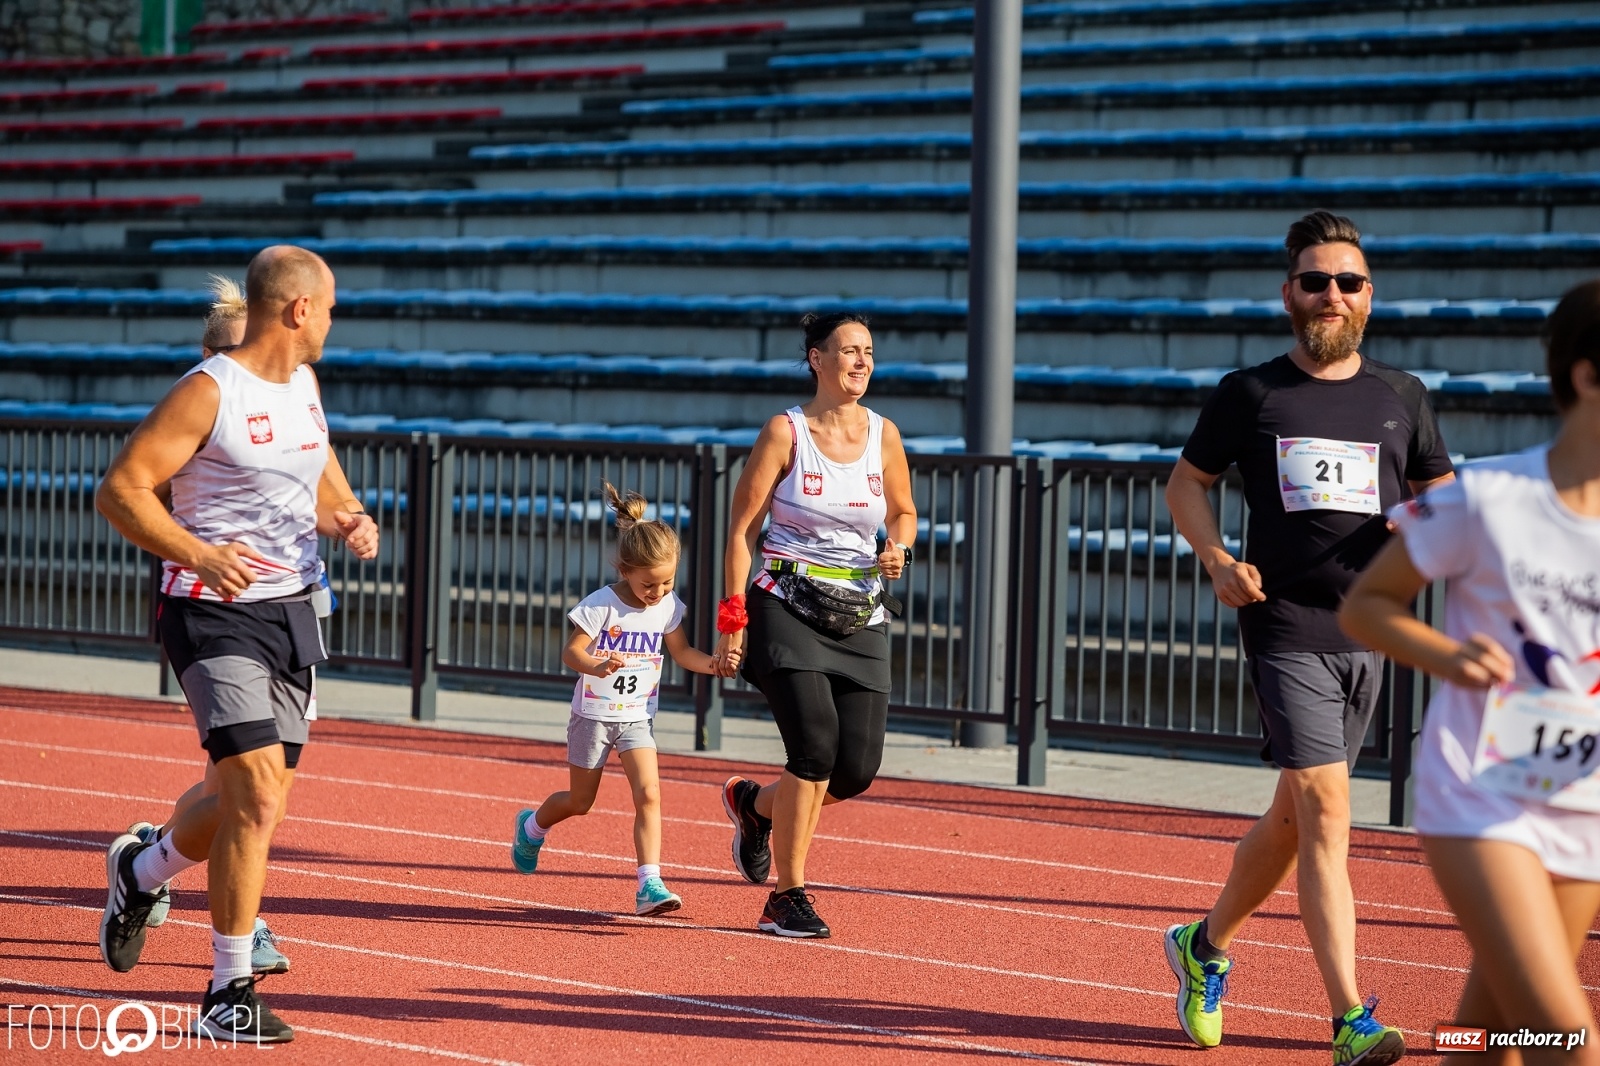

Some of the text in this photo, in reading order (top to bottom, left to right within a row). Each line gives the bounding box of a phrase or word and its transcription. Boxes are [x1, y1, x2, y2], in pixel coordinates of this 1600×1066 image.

[1383, 420, 1398, 430] 4F
[1315, 459, 1343, 484] 21
[612, 675, 638, 695] 43
[1534, 723, 1597, 767] 159
